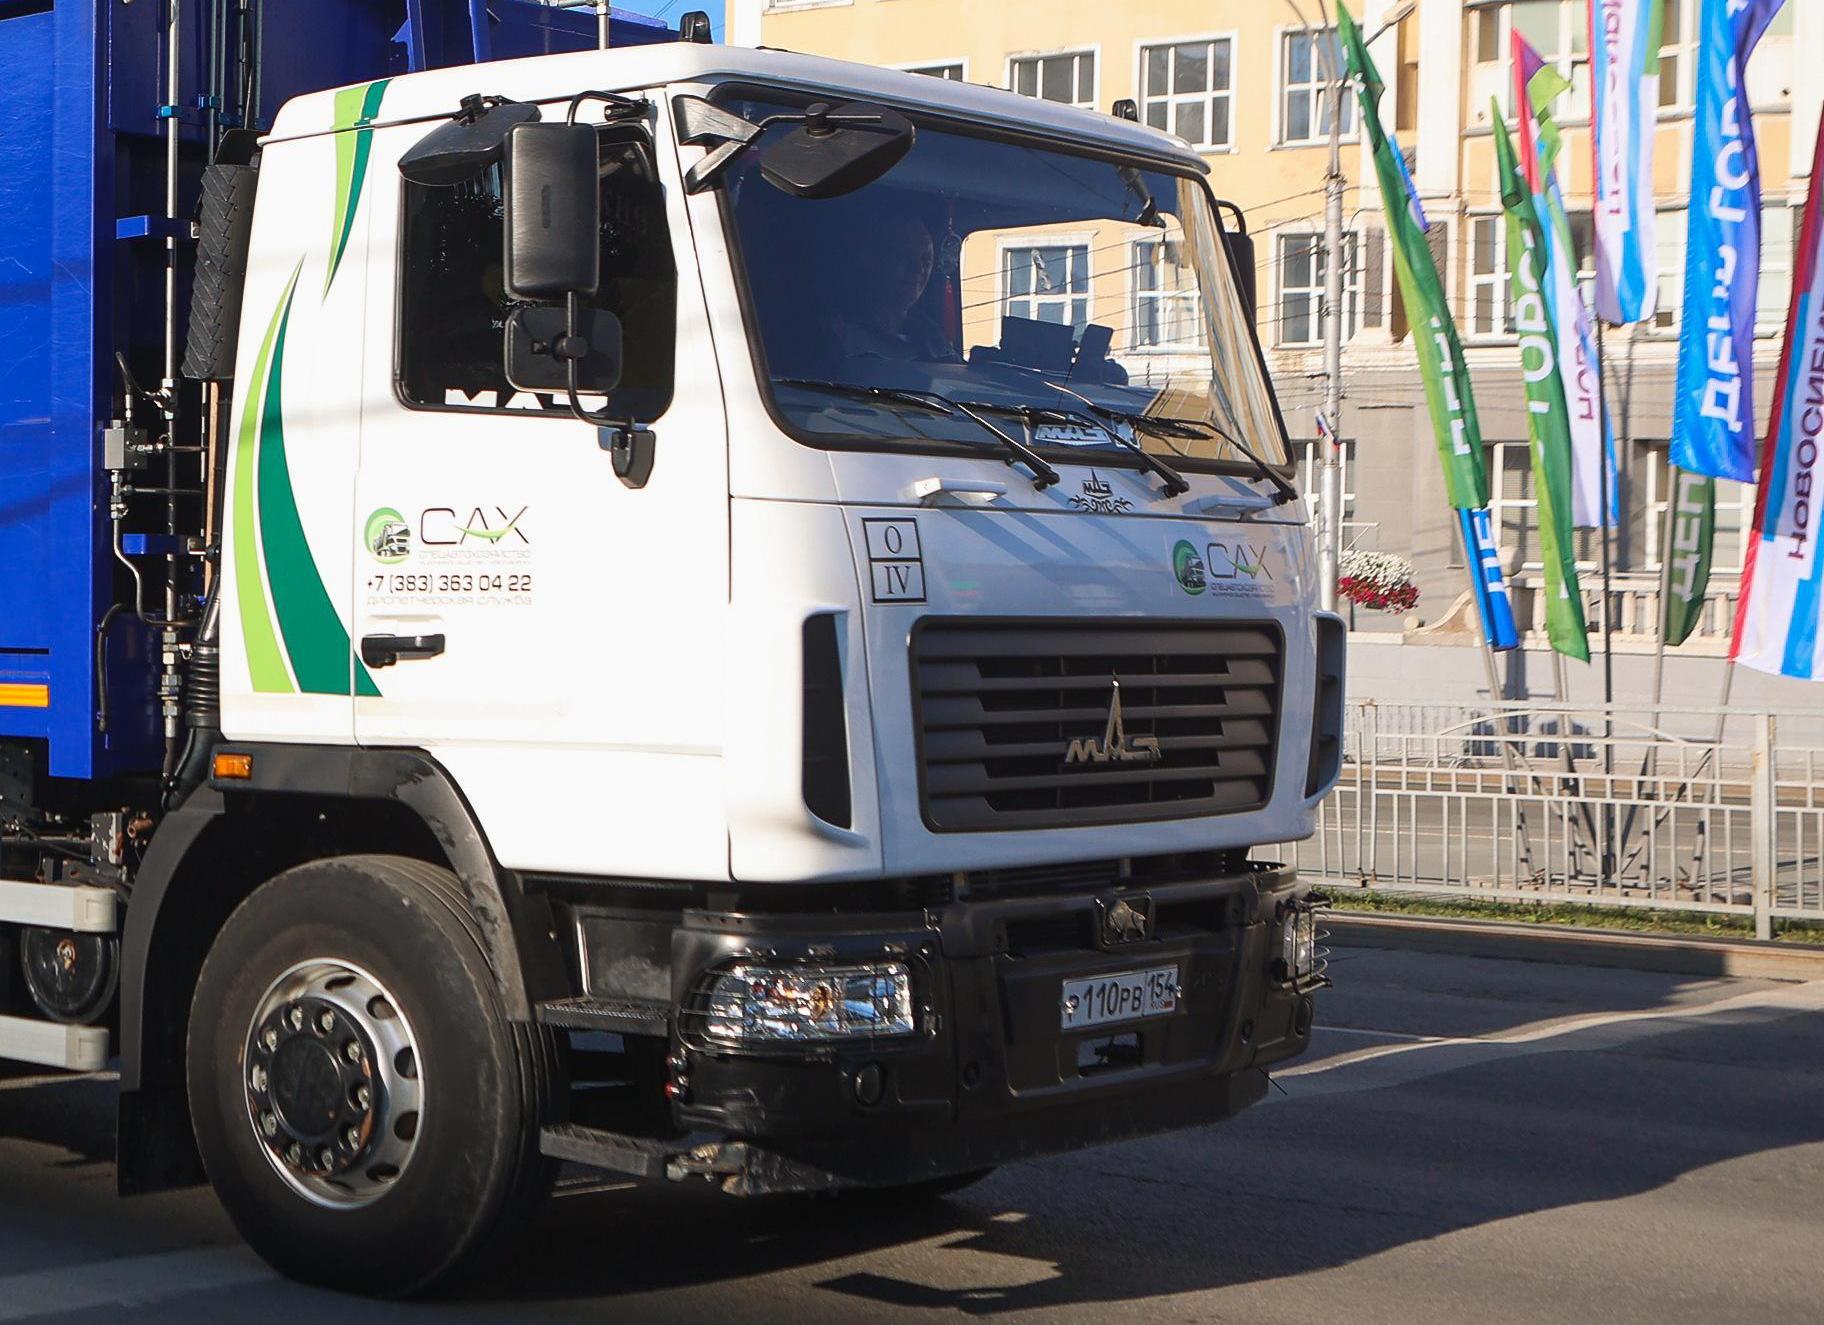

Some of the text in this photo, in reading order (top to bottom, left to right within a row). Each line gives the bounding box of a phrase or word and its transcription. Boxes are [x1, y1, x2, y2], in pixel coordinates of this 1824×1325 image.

[420, 505, 530, 544] САХ
[1206, 542, 1273, 581] САХ
[368, 574, 532, 593] +7 (383) 363 04 22
[884, 565, 911, 595] IV
[1147, 971, 1175, 1000] 154
